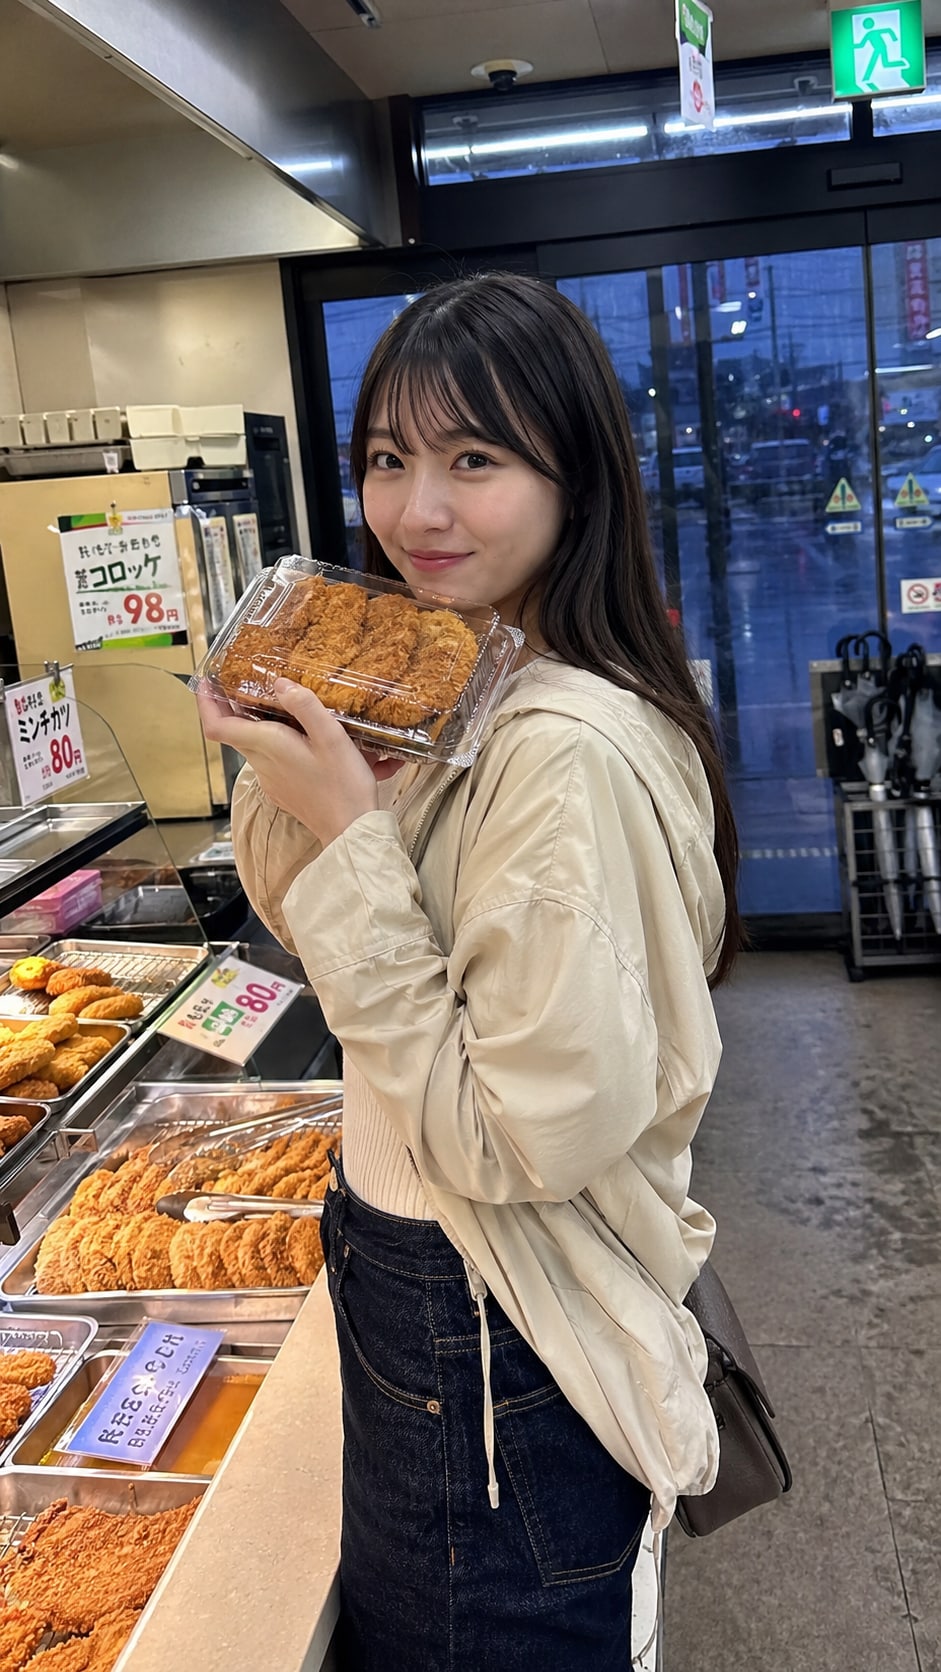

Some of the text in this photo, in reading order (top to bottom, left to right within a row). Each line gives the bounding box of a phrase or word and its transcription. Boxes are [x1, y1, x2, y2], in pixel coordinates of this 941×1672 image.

[123, 592, 179, 624] 98円
[18, 703, 70, 743] ミンチカツ
